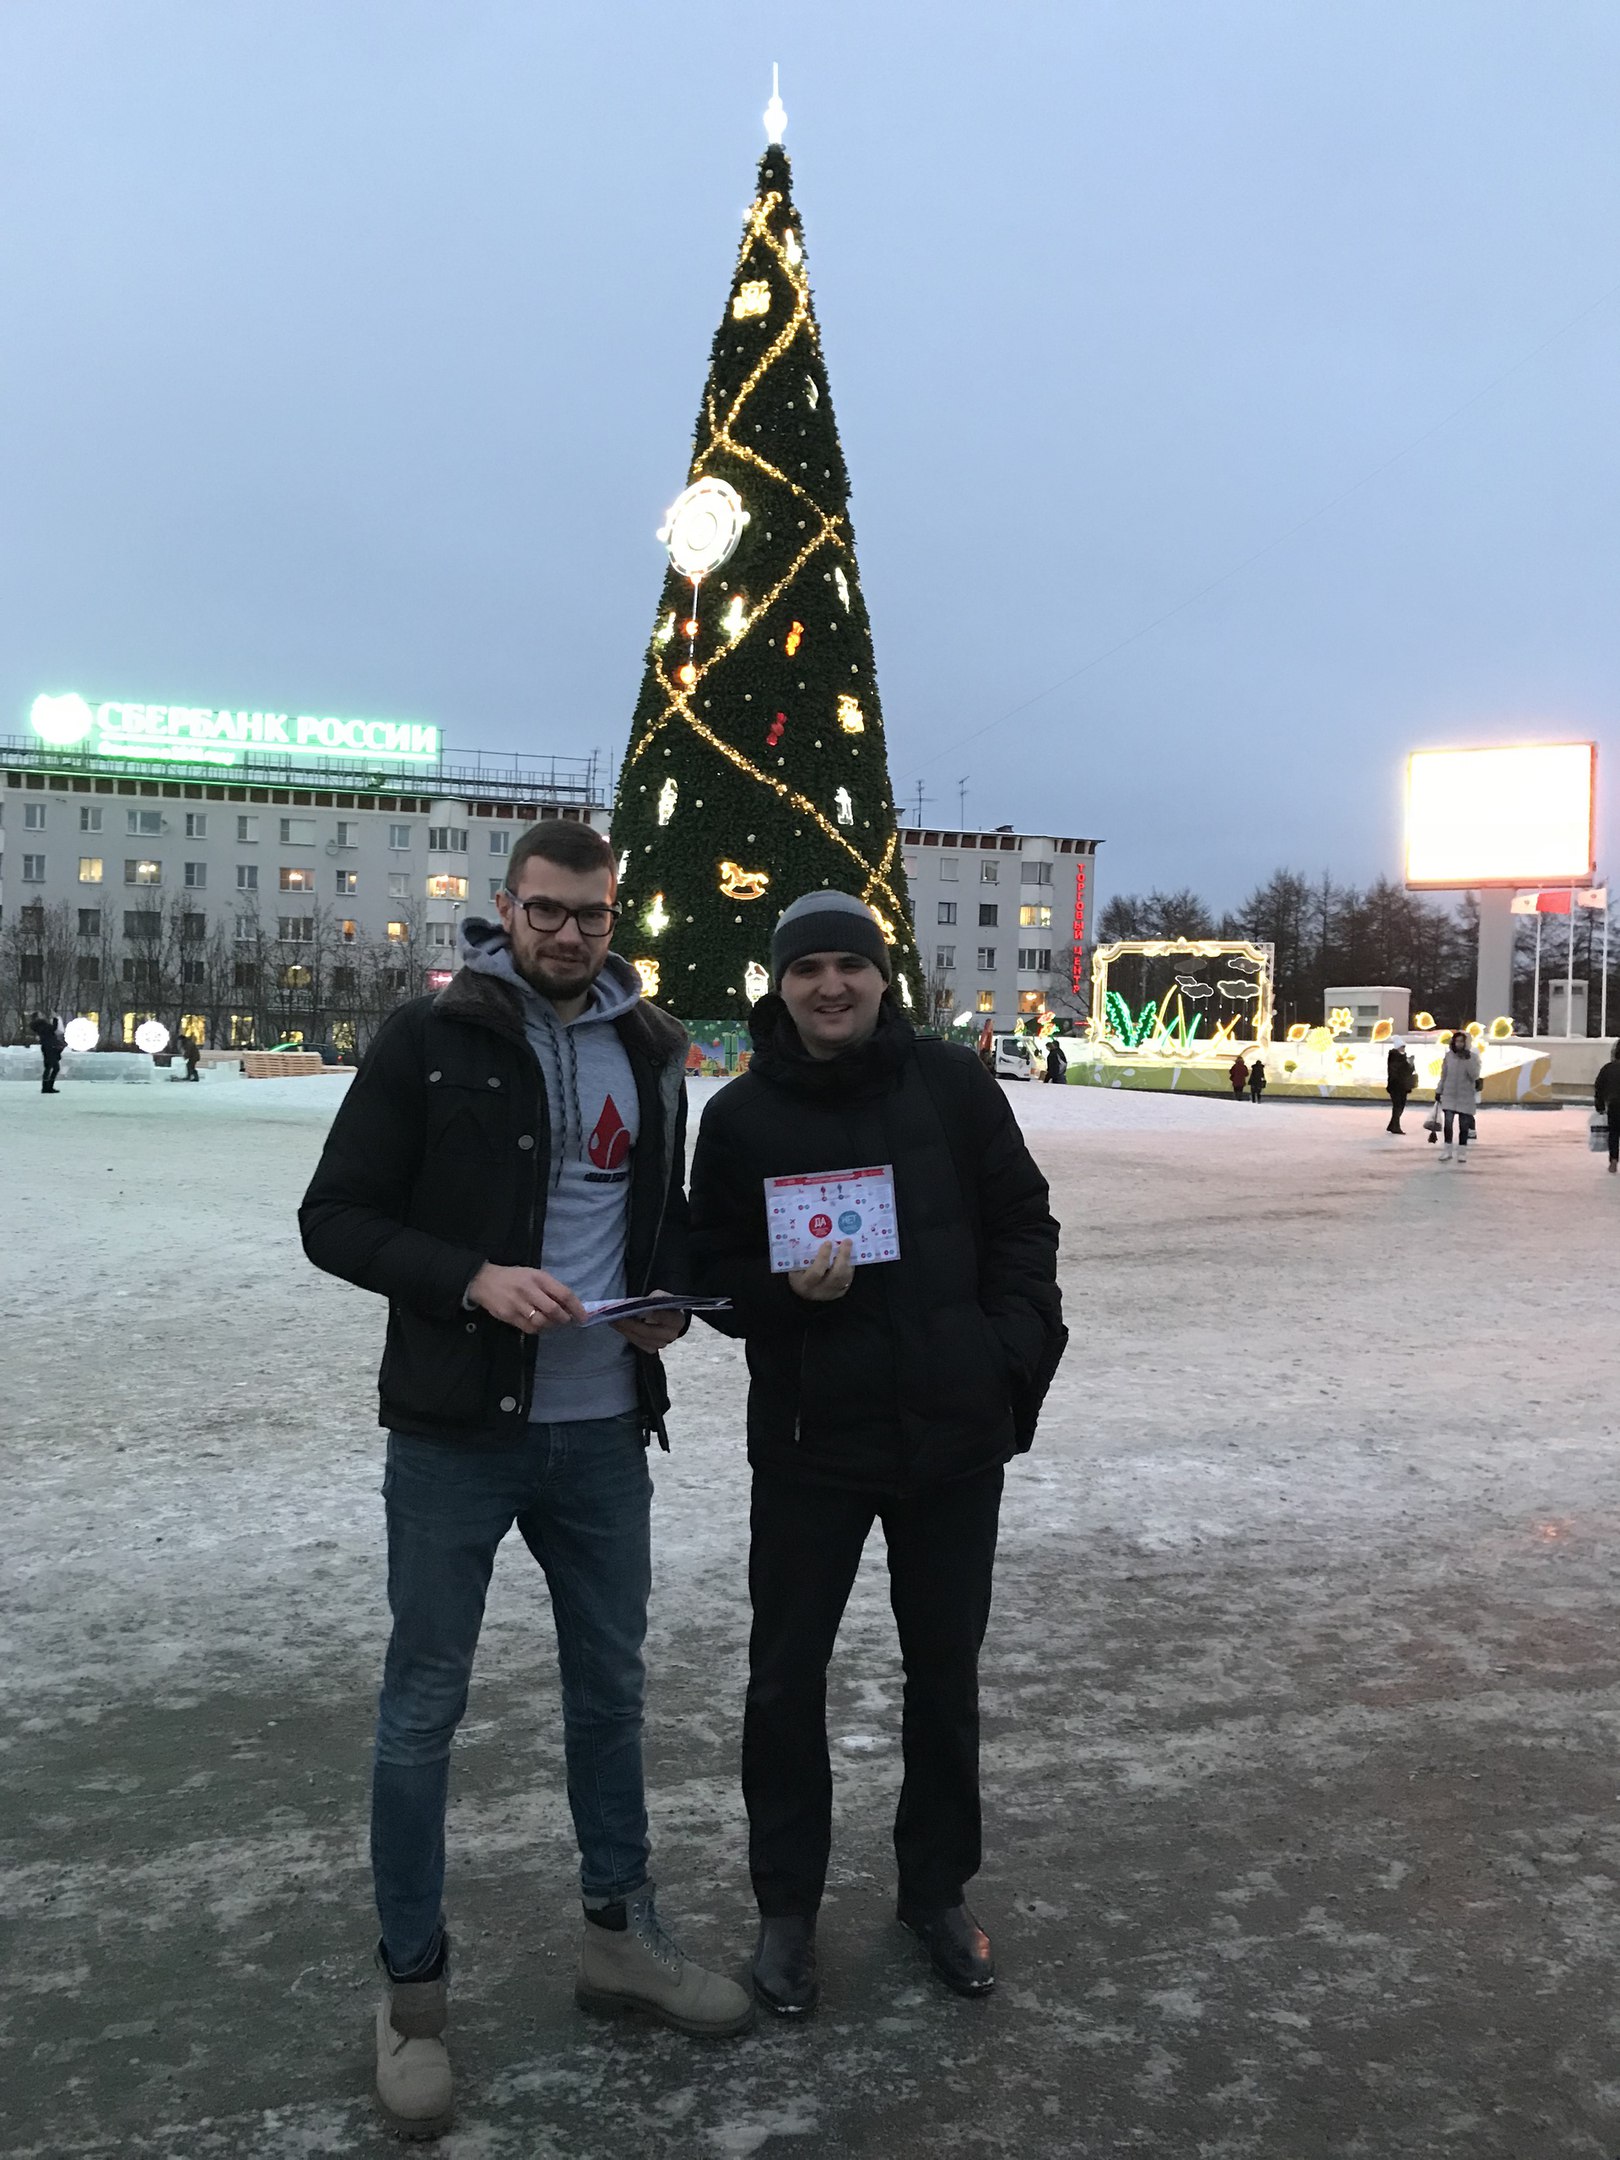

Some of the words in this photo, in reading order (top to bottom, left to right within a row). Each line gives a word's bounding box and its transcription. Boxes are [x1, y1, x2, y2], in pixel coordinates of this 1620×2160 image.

[98, 702, 290, 743] СБЕРБАНК
[296, 716, 438, 753] РОССИИ
[1073, 863, 1086, 940] ТОРГОВЫЙ
[1072, 946, 1084, 994] ЦЕНТР
[814, 1217, 827, 1229] ДА
